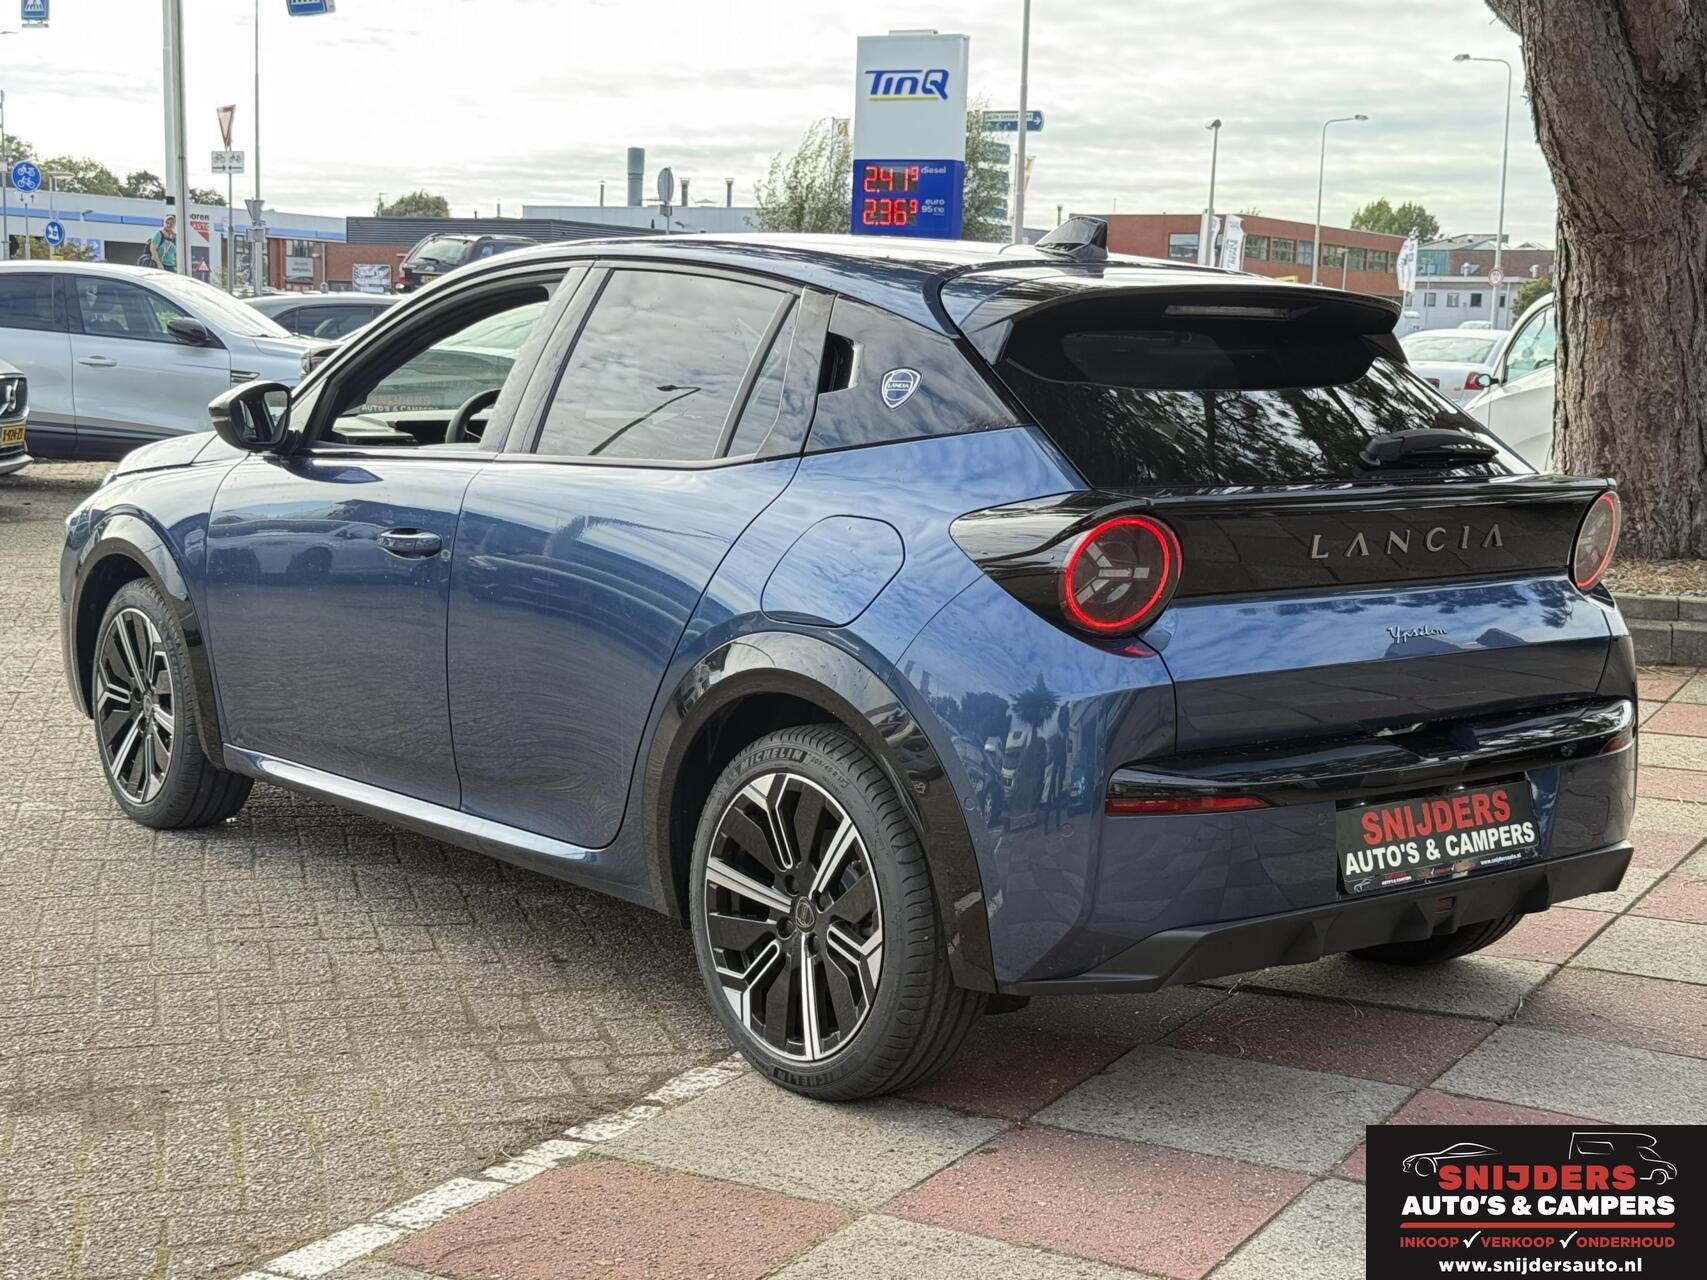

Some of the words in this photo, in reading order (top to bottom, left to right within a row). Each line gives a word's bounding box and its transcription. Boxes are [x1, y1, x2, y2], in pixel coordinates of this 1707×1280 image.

[865, 69, 949, 100] TinQ
[920, 166, 946, 174] diesel
[1311, 523, 1504, 560] LANCIA
[1386, 624, 1448, 645] Ypsilon
[740, 748, 804, 770] MICHELIN
[1361, 790, 1511, 845] SNIJDERS
[1345, 841, 1420, 876] AUTO'S
[1426, 838, 1441, 861] &
[1445, 821, 1536, 857] CAMPERS
